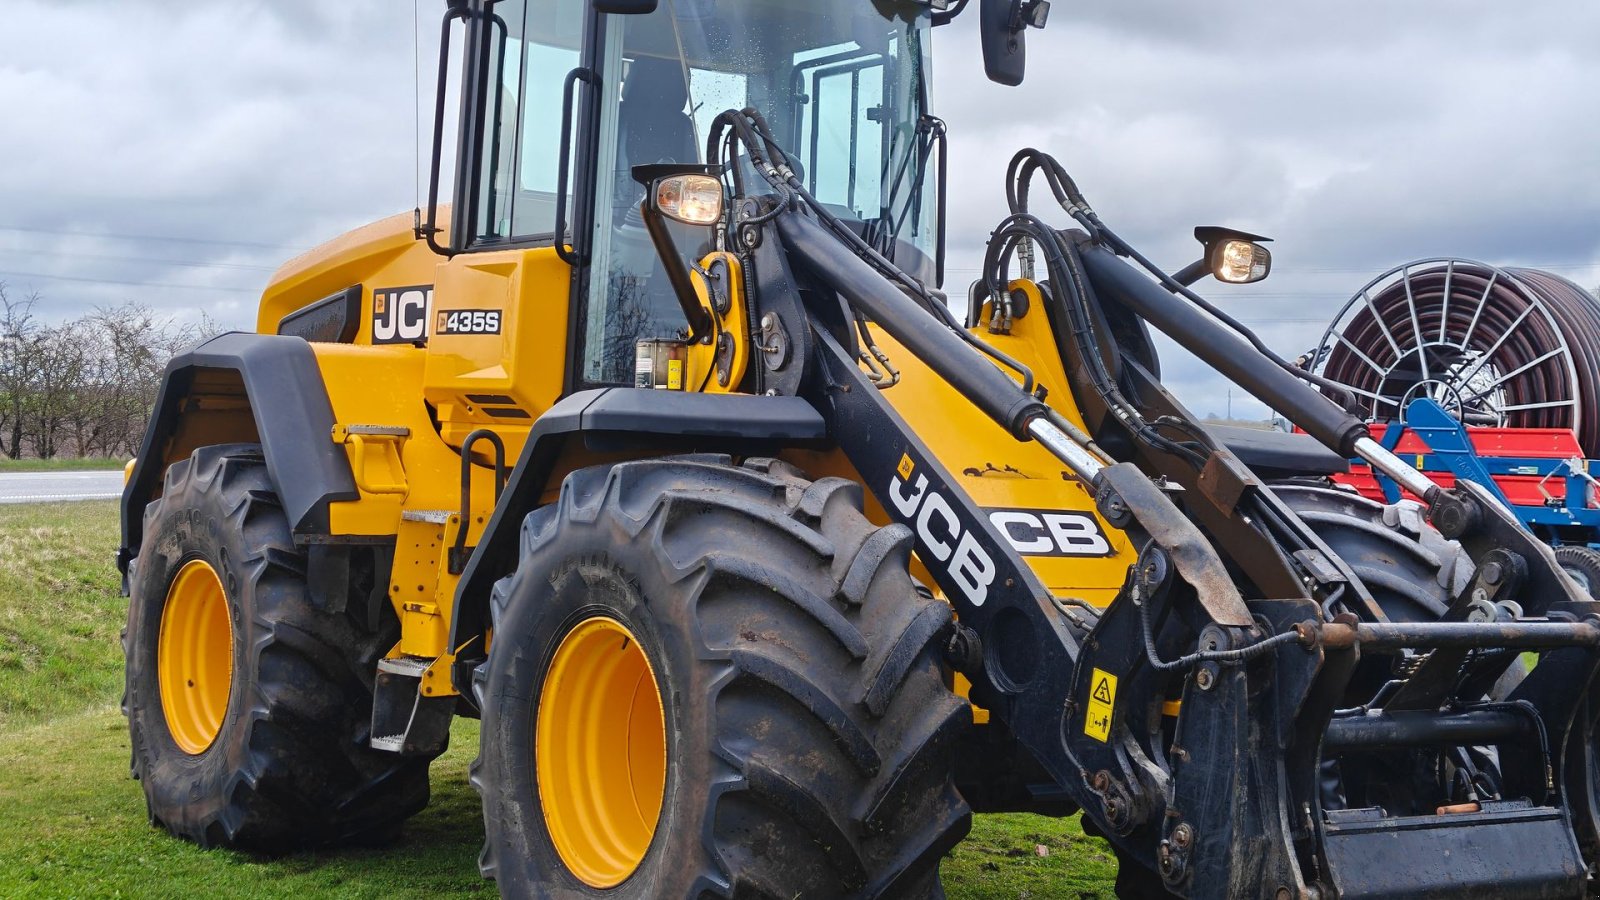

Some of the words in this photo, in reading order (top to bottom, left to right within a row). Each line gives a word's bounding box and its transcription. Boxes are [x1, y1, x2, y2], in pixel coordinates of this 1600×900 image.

[374, 290, 434, 340] JC
[447, 311, 499, 332] 435S
[889, 473, 996, 607] JCB
[989, 511, 1110, 554] CB
